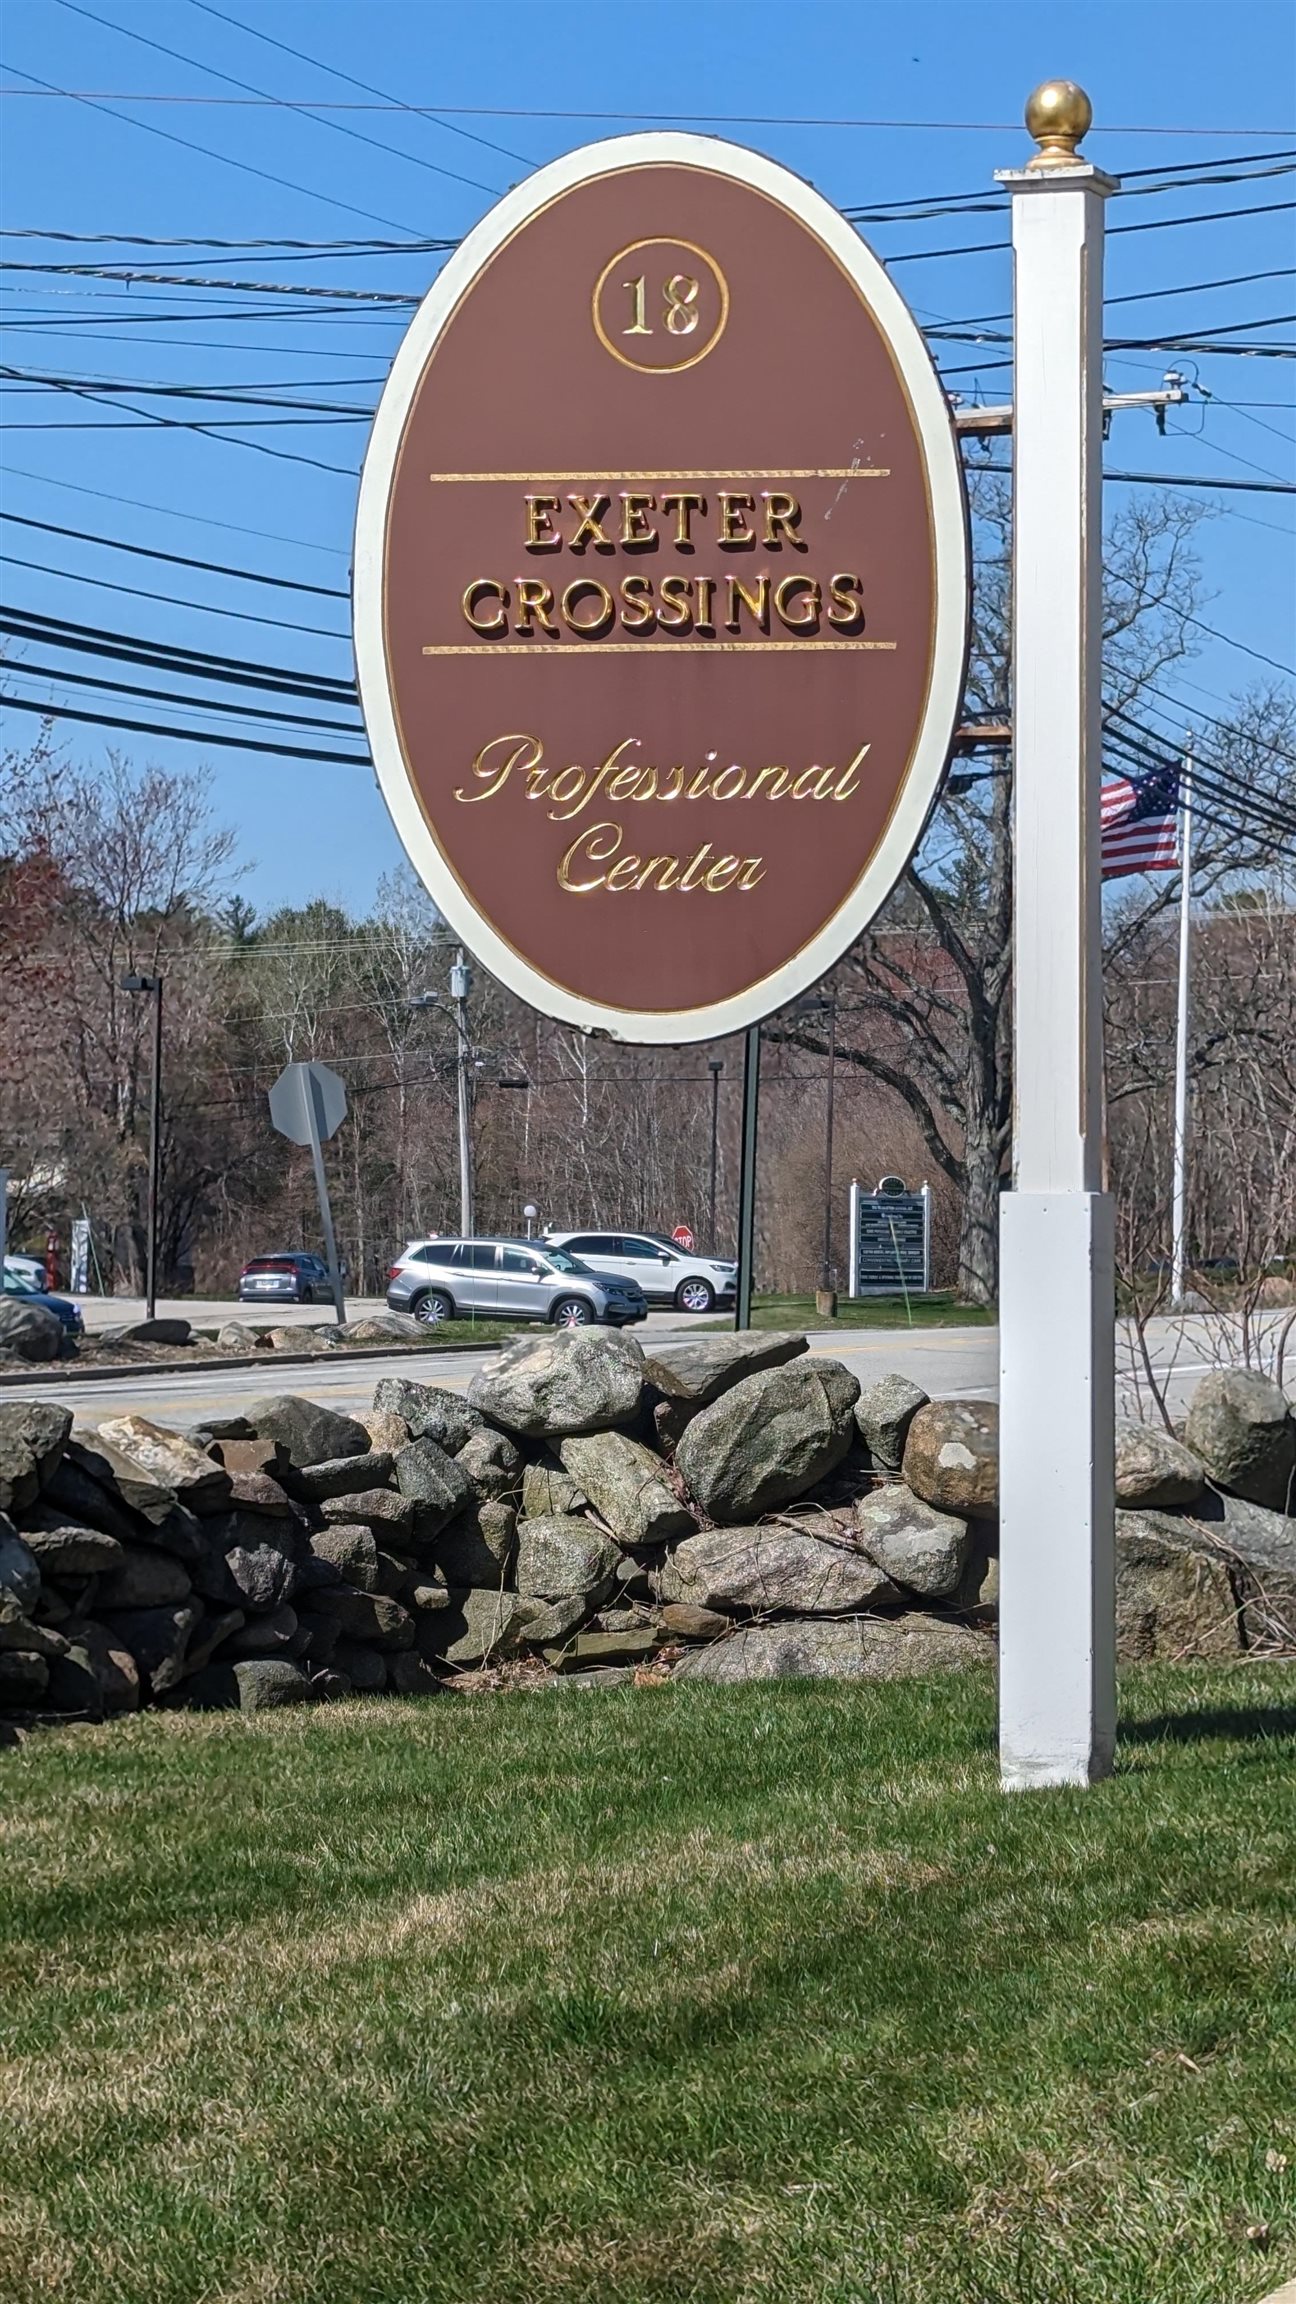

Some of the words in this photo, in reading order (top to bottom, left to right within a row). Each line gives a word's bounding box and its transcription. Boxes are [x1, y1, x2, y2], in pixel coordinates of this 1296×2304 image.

[621, 274, 700, 335] 18
[523, 489, 806, 550] EXETER
[460, 572, 864, 634] CROSSINGS
[454, 733, 872, 822] Professional
[556, 821, 768, 894] Center
